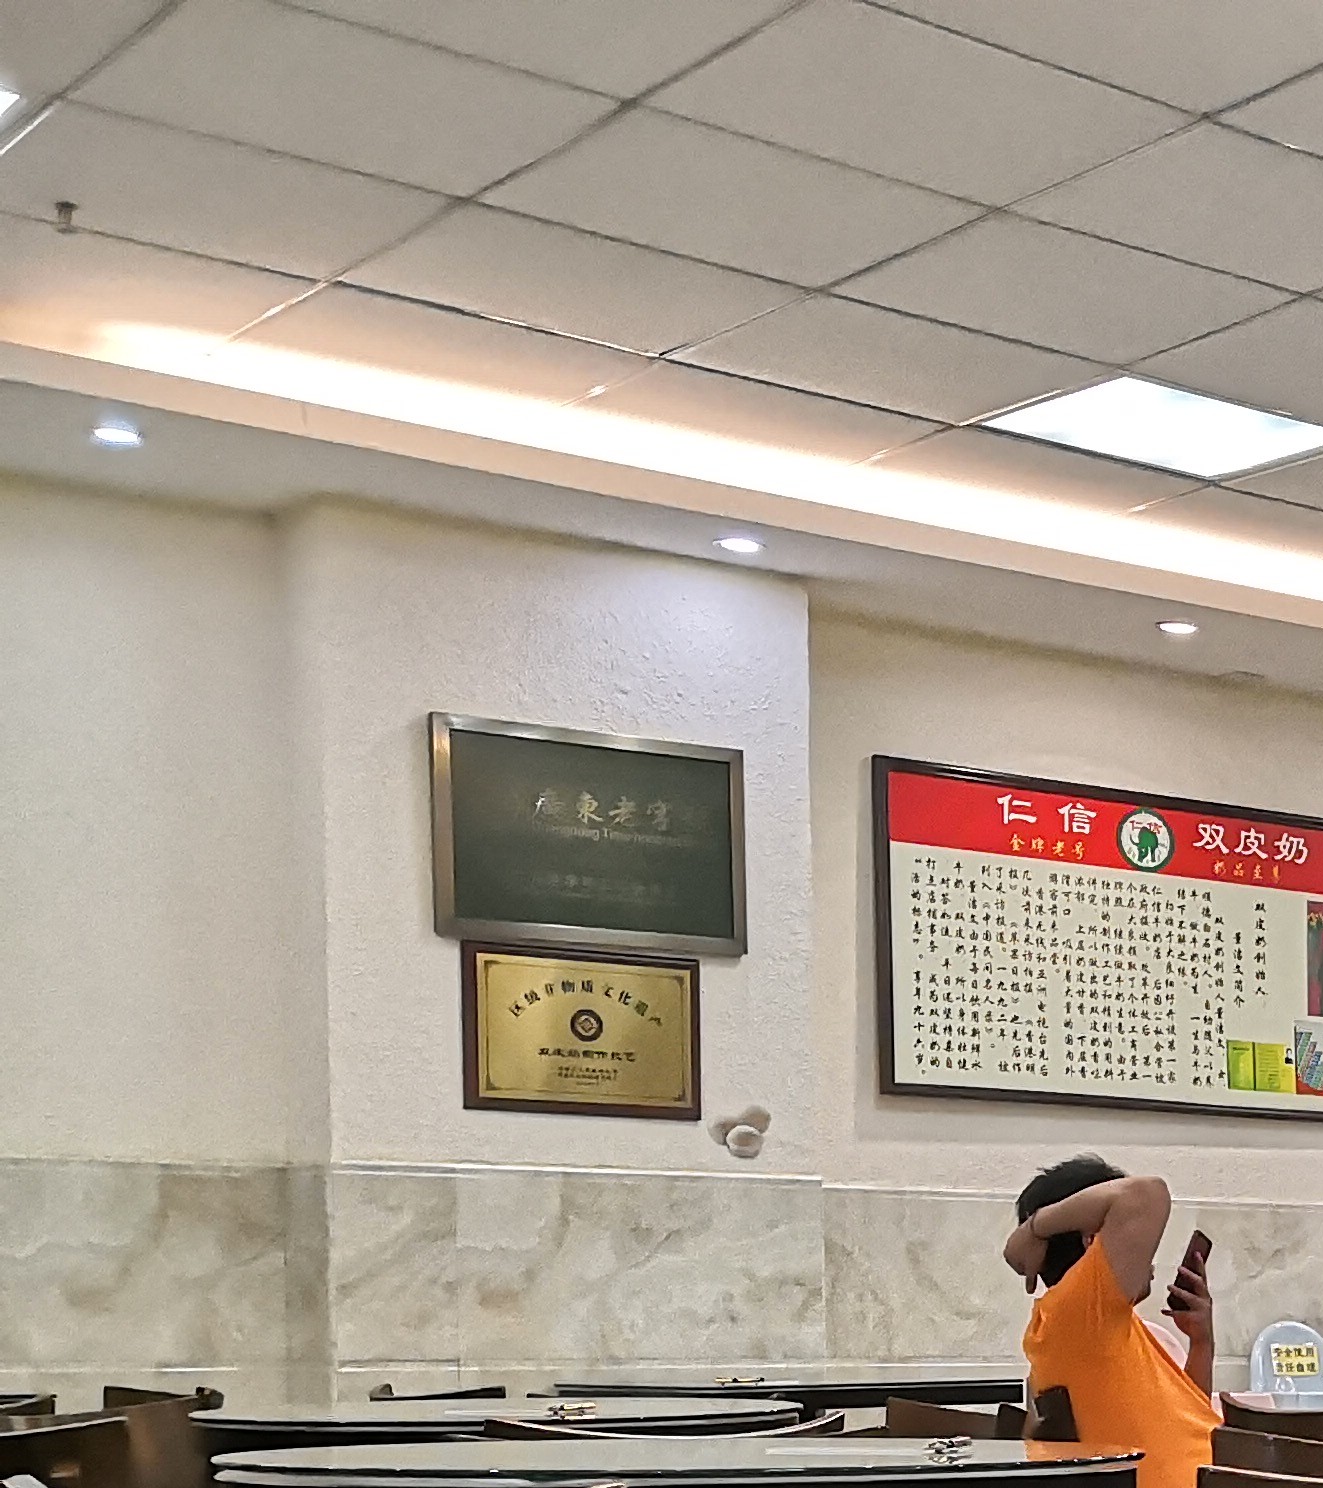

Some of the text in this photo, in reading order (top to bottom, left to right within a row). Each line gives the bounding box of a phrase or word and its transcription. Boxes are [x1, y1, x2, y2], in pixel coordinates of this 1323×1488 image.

[996, 793, 1310, 865] 仁信 双皮奶
